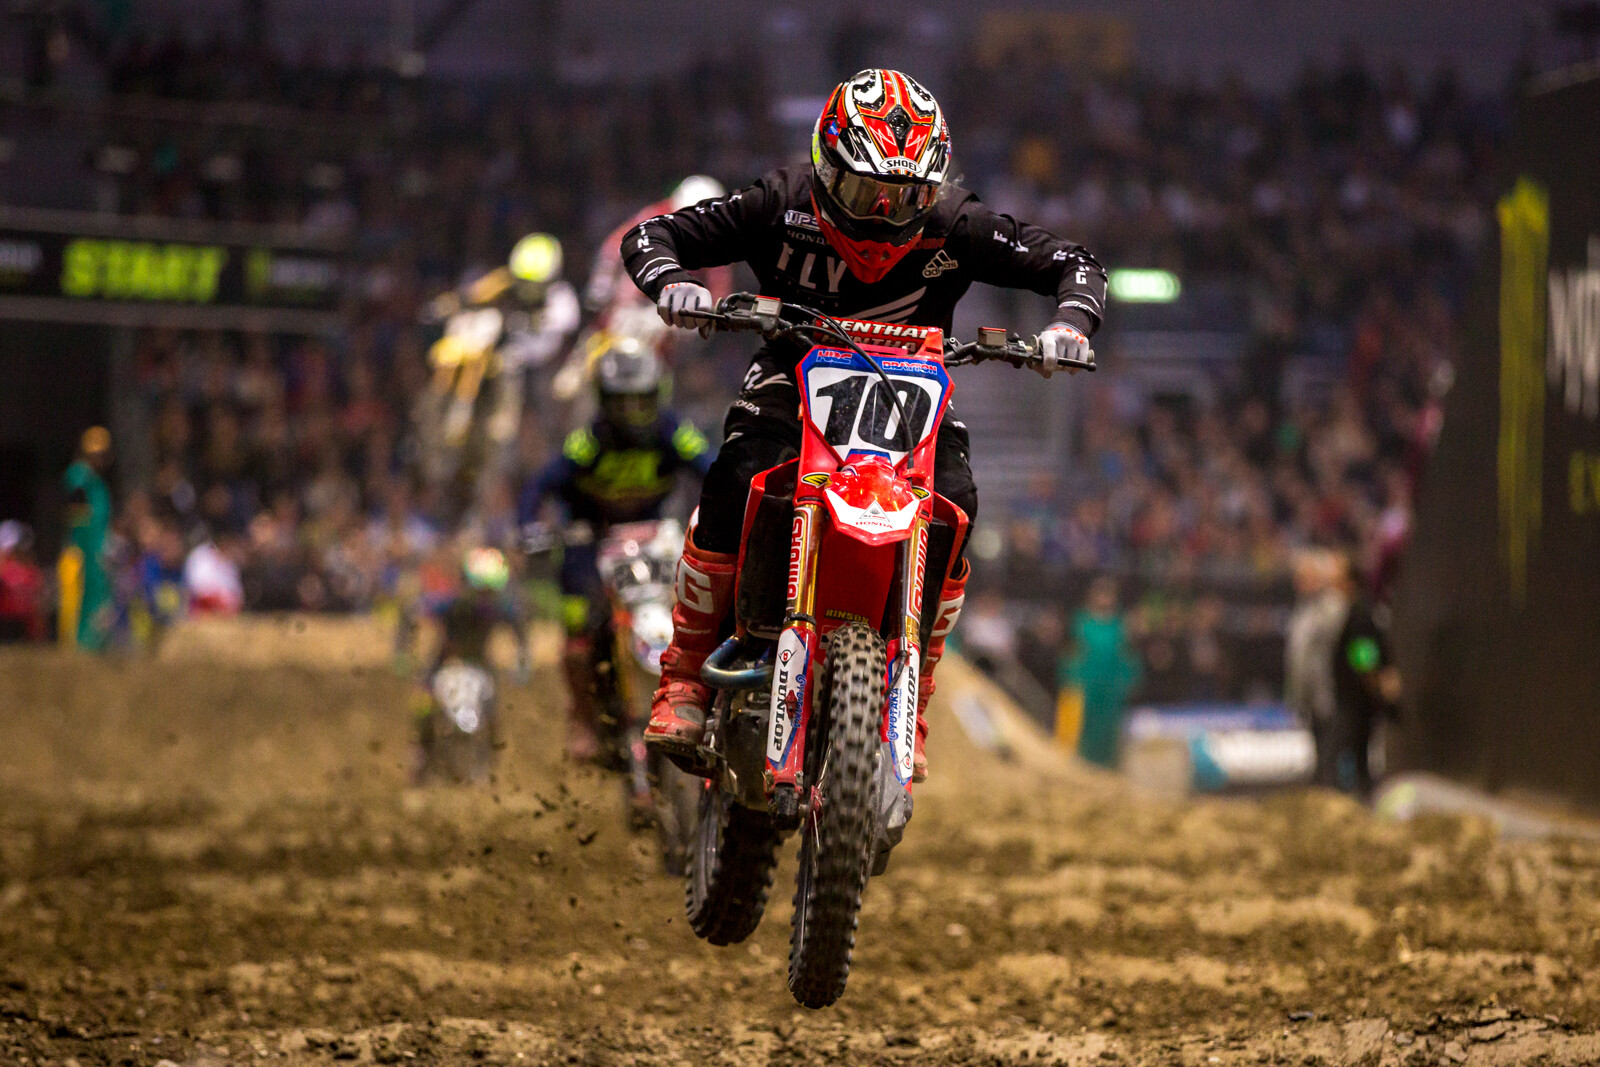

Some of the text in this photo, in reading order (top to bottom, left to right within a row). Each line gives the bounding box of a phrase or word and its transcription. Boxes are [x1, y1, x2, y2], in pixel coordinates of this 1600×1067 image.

[885, 159, 918, 172] SHOEI
[786, 229, 827, 246] HOND
[776, 241, 848, 293] FLY
[816, 350, 853, 364] HRC
[881, 360, 938, 375] DRAYTON
[733, 399, 760, 416] ONDA
[815, 375, 932, 452] 10
[855, 520, 894, 530] HONDA
[773, 668, 789, 751] DUNLOP
[905, 665, 918, 750] DUNLOP
